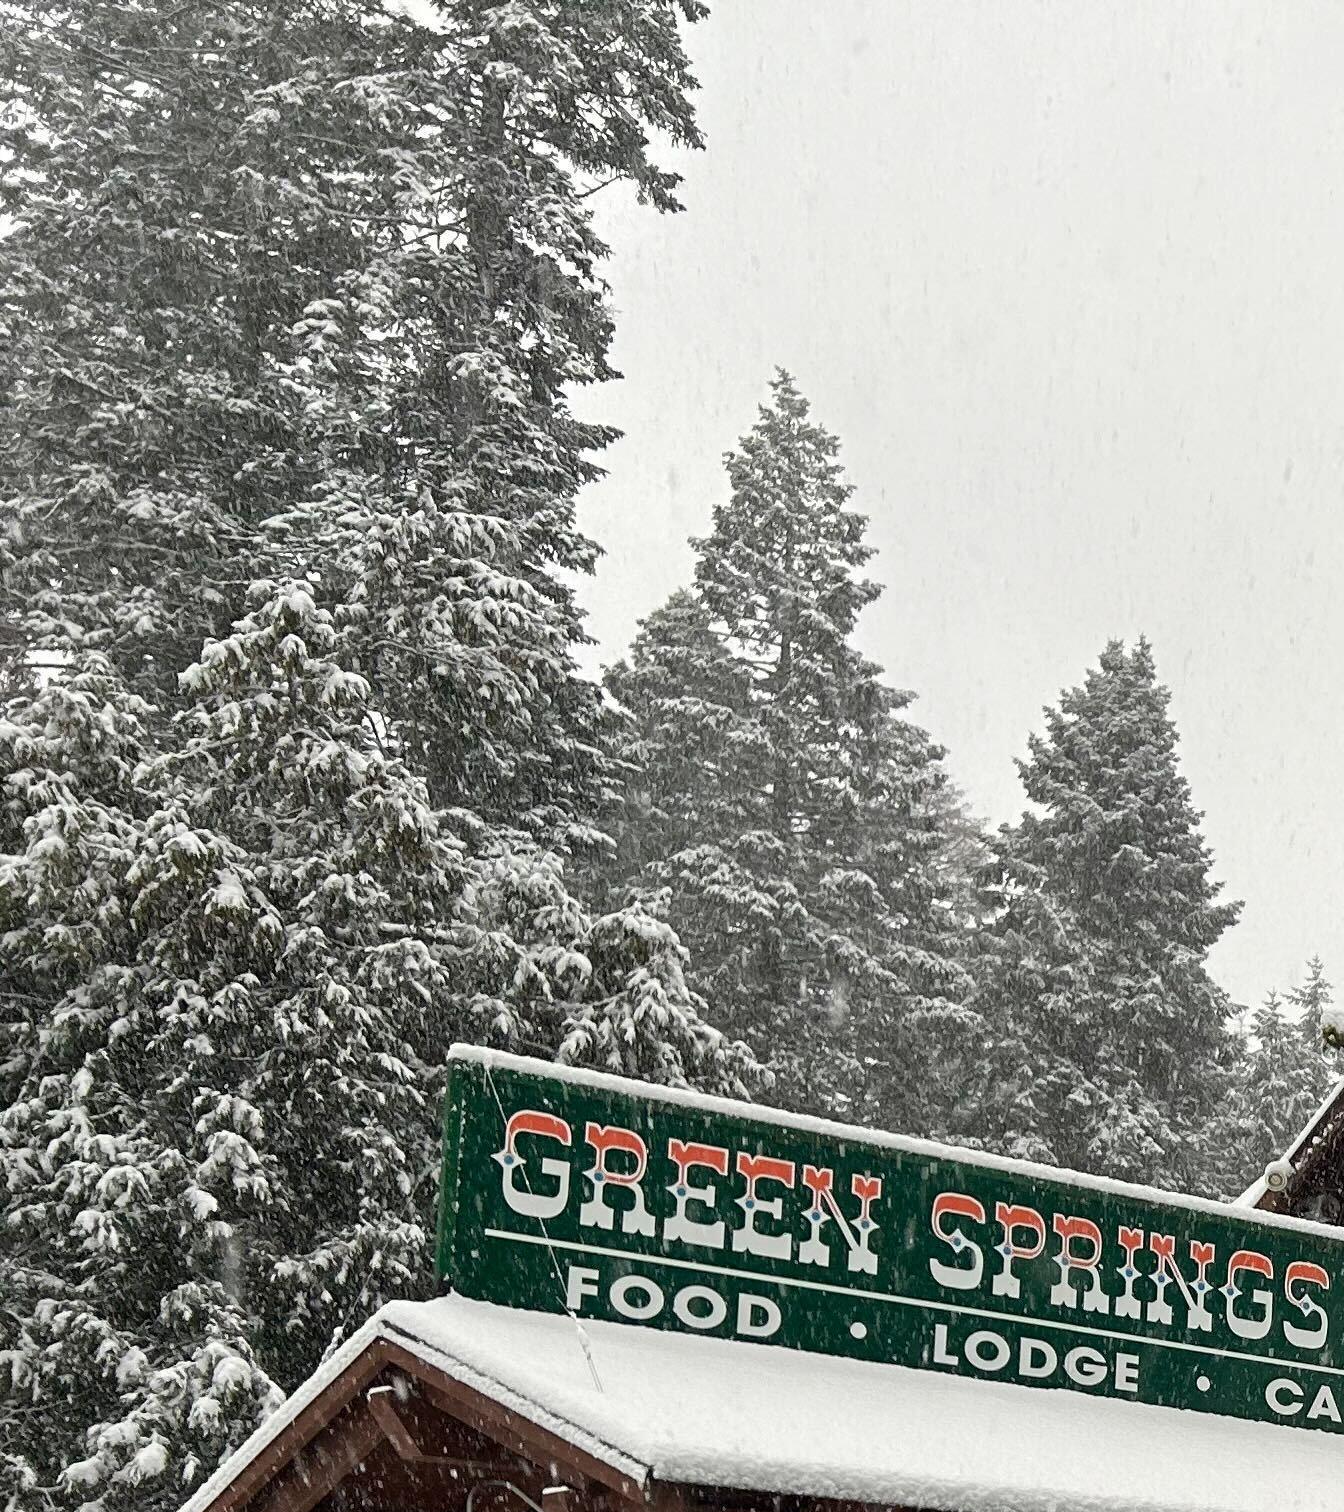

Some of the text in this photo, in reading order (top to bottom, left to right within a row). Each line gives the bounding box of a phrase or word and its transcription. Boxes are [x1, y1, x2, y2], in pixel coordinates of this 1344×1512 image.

[490, 1109, 881, 1275] GREEN
[930, 1192, 1330, 1350] SPRINGS
[565, 1265, 782, 1337] FOOD
[933, 1323, 1139, 1392] LODGE
